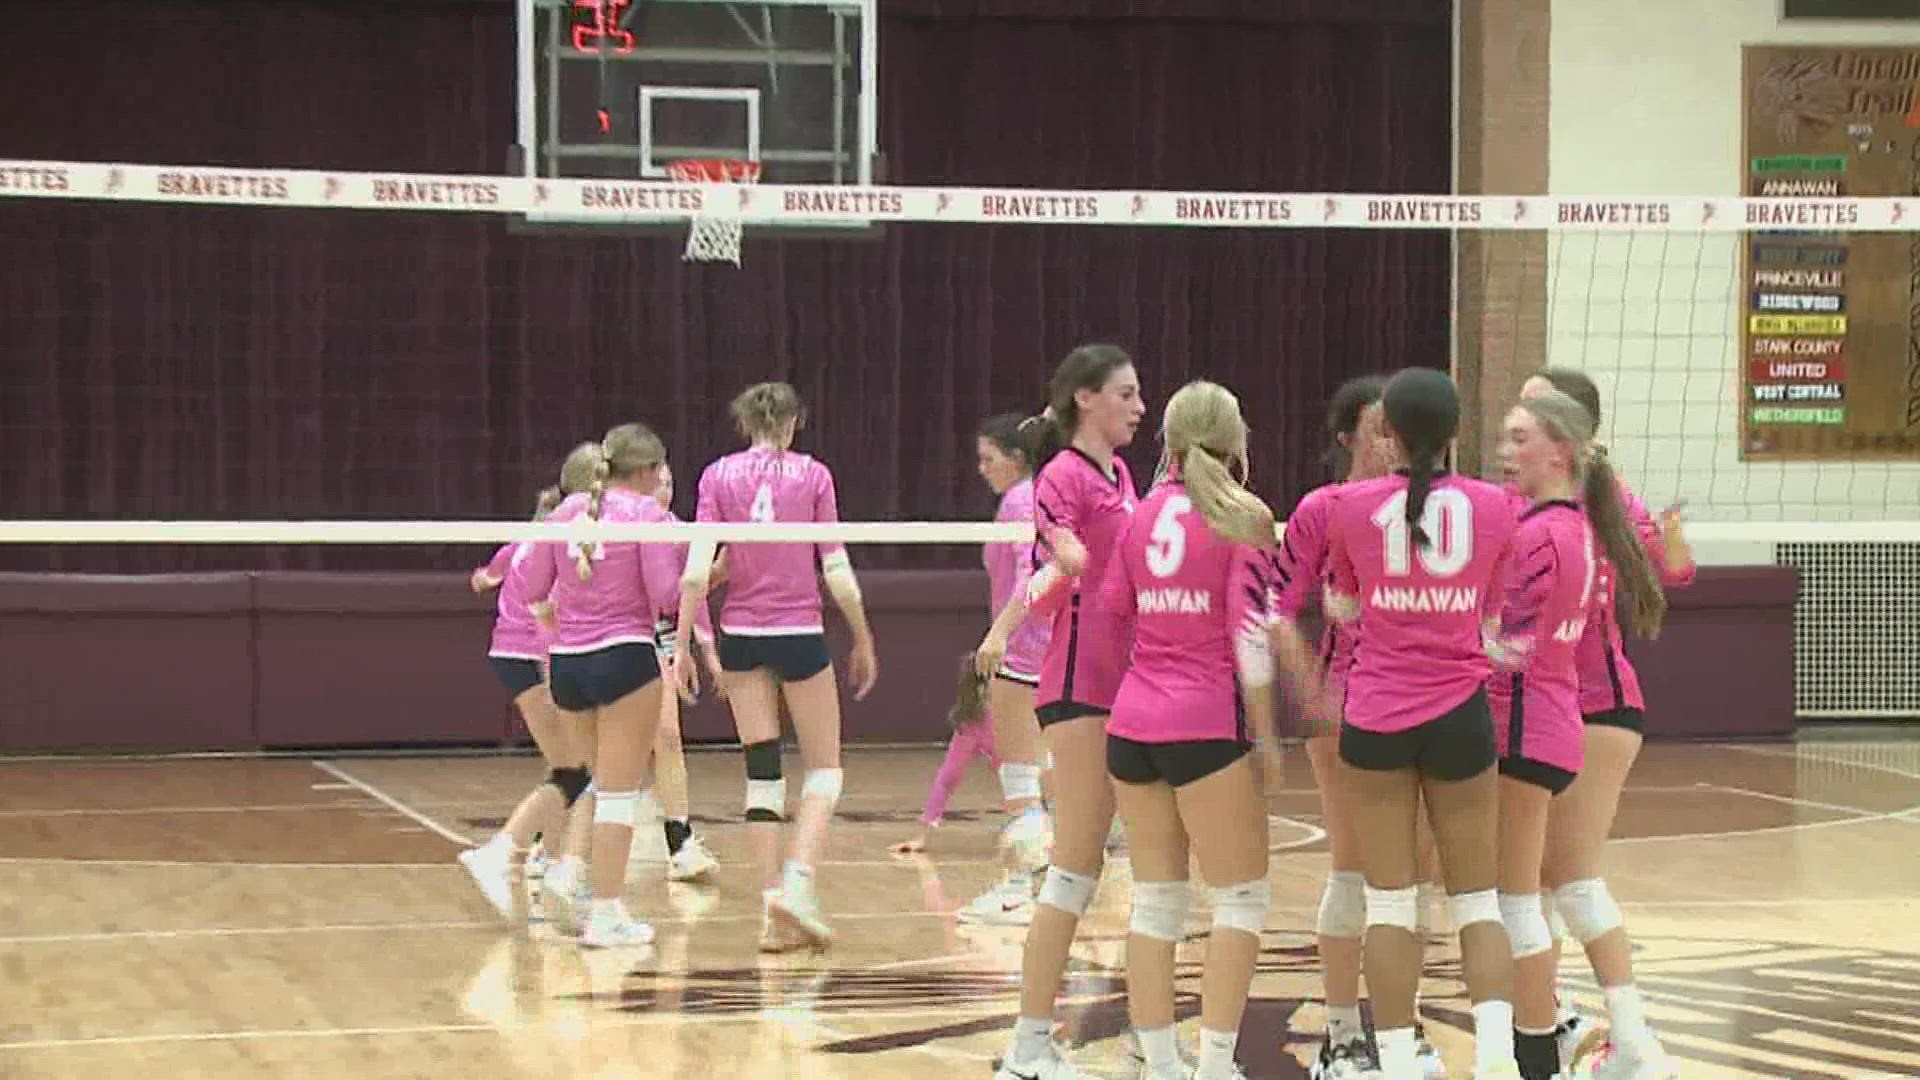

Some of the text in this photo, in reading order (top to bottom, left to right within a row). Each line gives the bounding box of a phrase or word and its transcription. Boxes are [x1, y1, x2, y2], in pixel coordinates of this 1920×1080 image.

[1761, 179, 1840, 195] ANNAWAN
[157, 172, 289, 199] BRAVETTES
[372, 179, 500, 205] BRAVETTES
[580, 183, 704, 211] BRAVETTES
[784, 188, 903, 214] BRAVETTES
[982, 195, 1098, 219] BRAVETTES
[1175, 199, 1292, 221] BRAVETTES
[1367, 201, 1482, 223] BRAVETTES
[1557, 202, 1671, 224] BRAVETTES
[1745, 203, 1859, 225] BRAVETTES
[1754, 271, 1841, 288] PRINCEVILLE
[1794, 338, 1842, 354] COUNTY
[1768, 362, 1827, 378] UNITED
[1144, 495, 1193, 579] 5
[1369, 486, 1474, 578] 10
[1370, 587, 1477, 613] ANNAWAN
